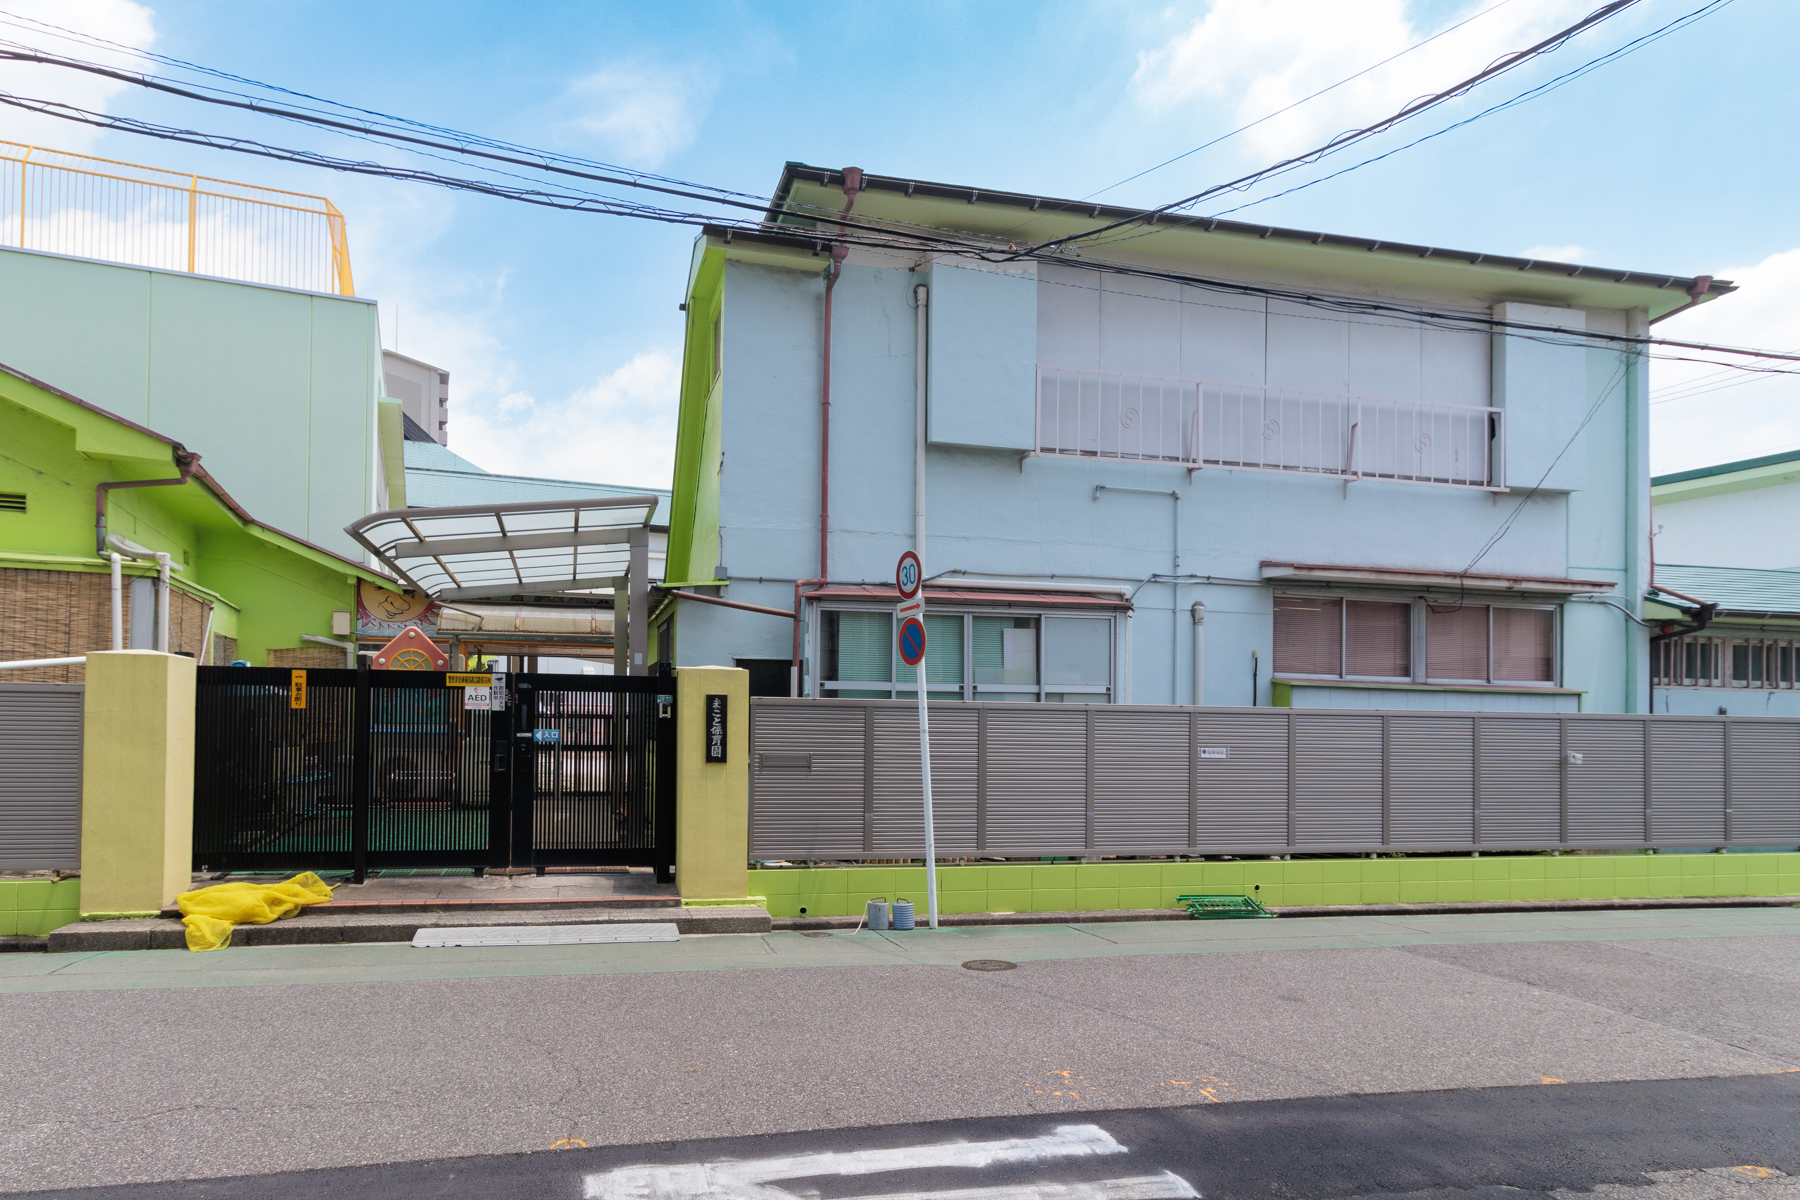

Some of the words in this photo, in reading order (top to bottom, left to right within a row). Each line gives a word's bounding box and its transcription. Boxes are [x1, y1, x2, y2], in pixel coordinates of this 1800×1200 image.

[902, 564, 915, 586] 30
[710, 698, 722, 758] まこと保育園
